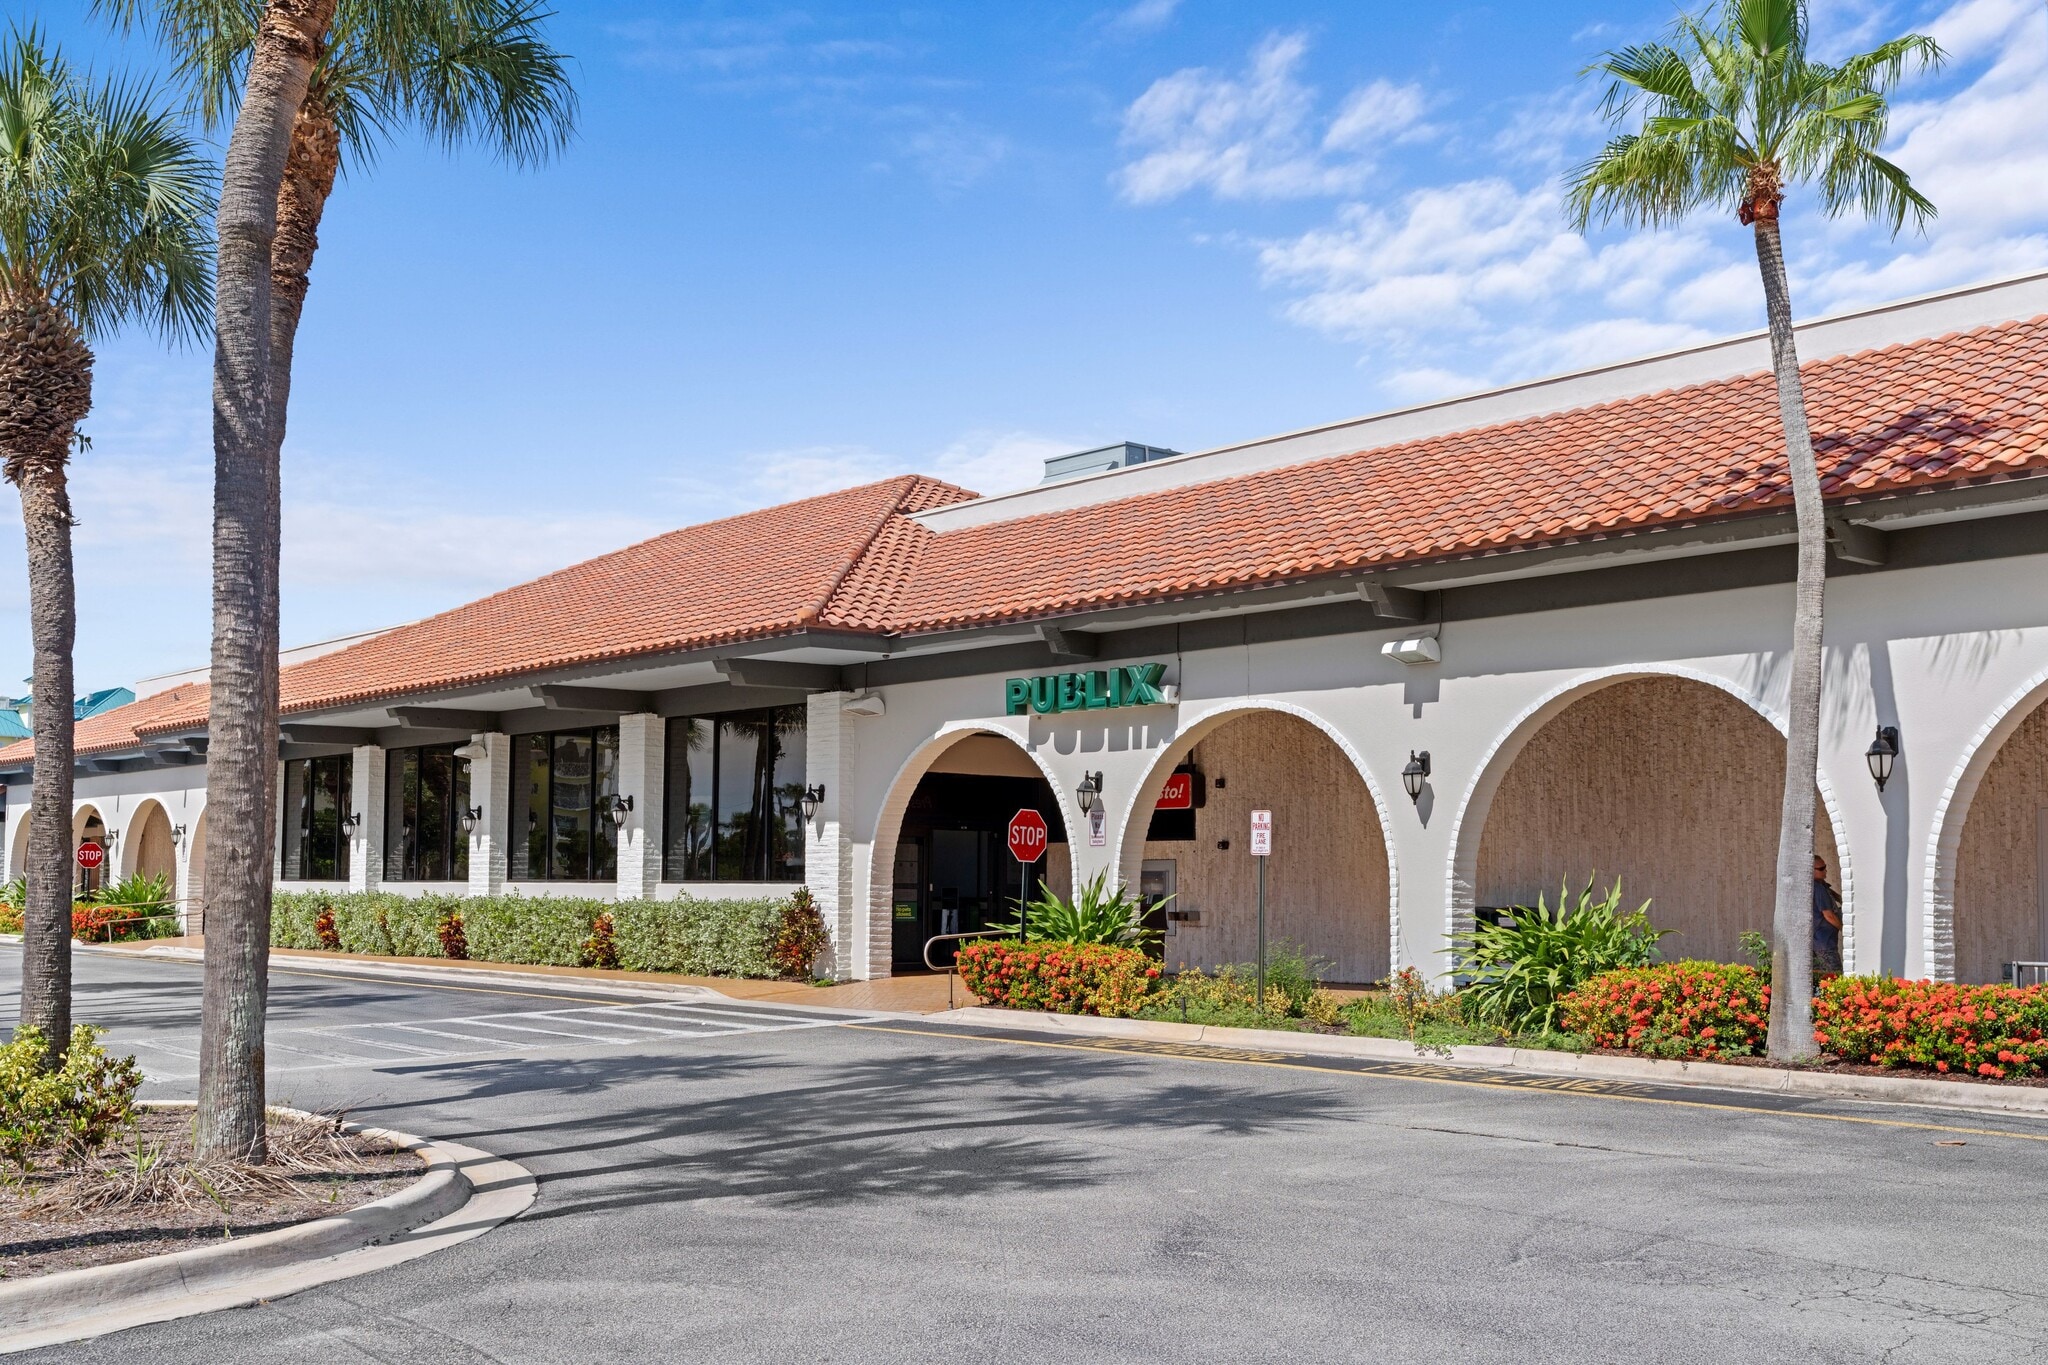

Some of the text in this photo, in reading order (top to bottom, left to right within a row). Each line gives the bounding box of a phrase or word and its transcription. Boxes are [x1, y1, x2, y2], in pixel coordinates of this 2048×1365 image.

[1005, 663, 1167, 715] PUBLIX
[1012, 826, 1044, 846] STOP
[79, 850, 101, 860] STOP
